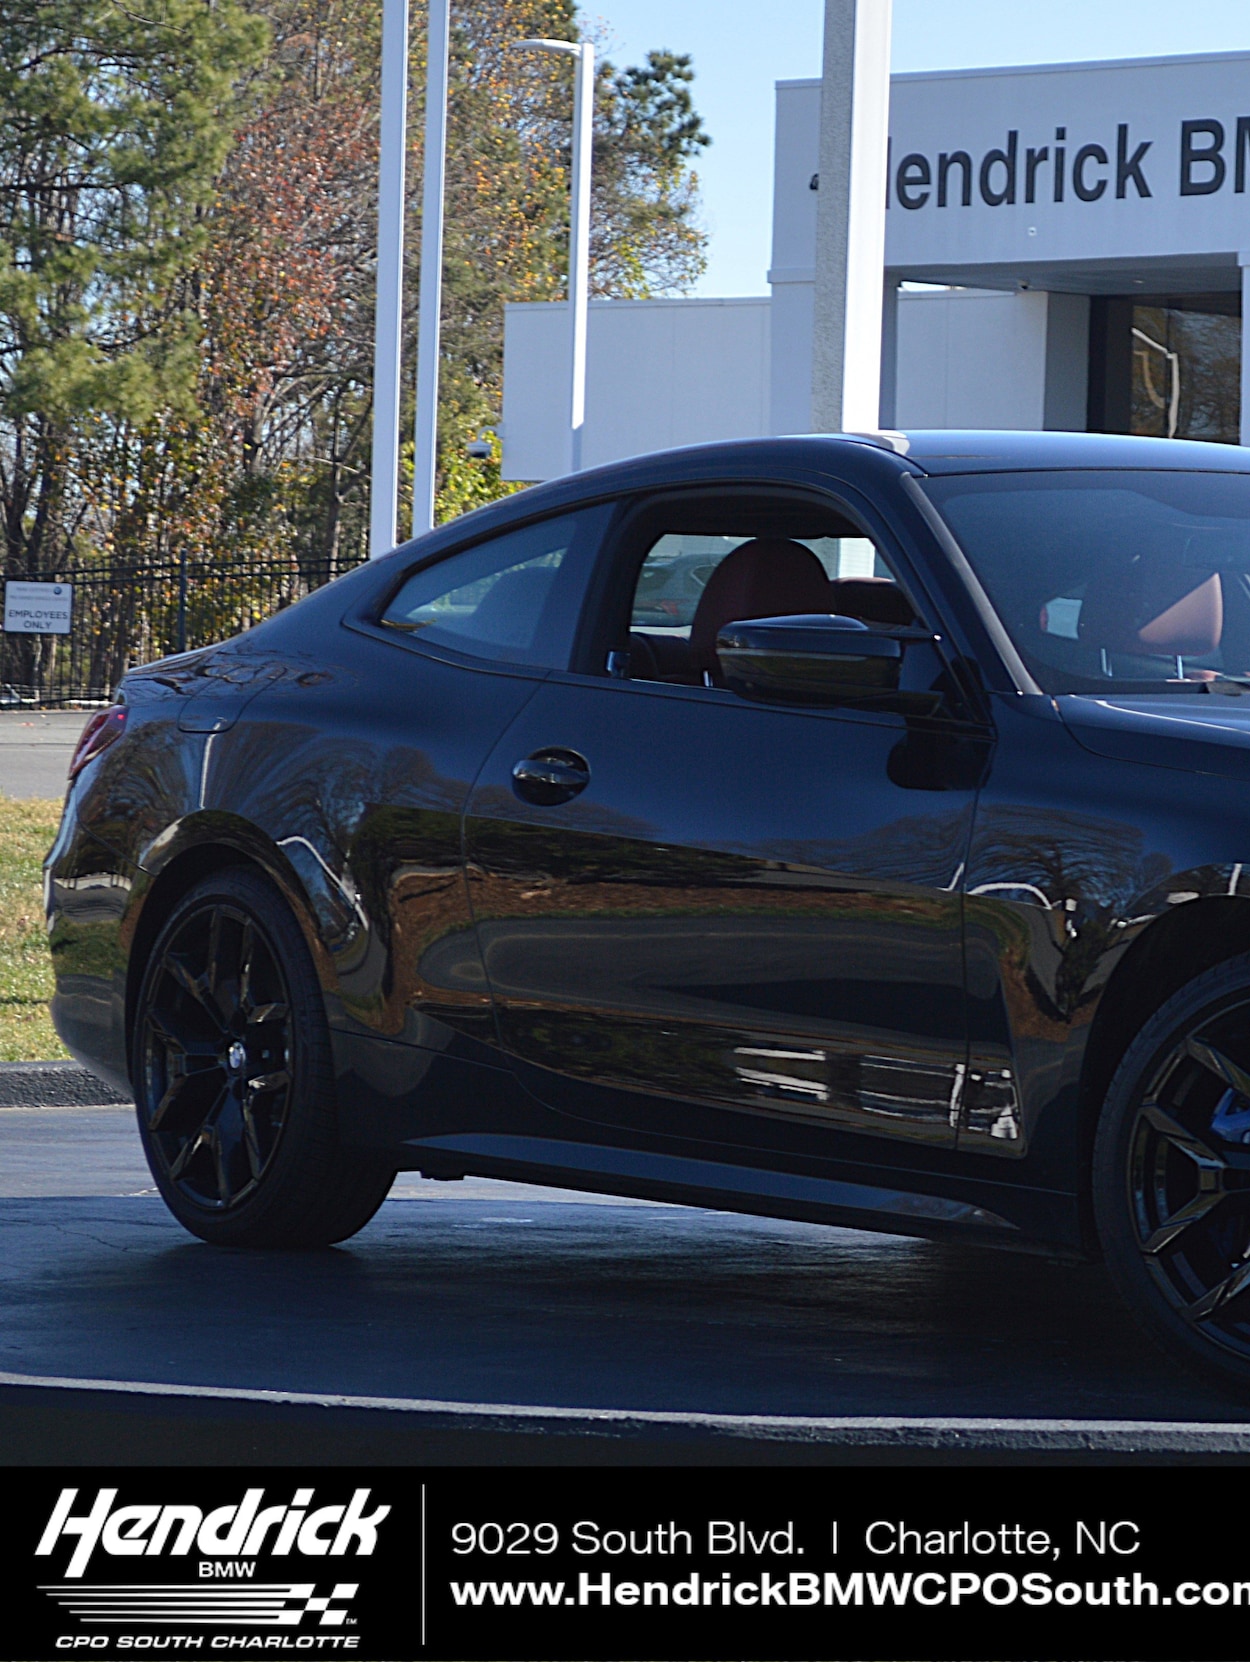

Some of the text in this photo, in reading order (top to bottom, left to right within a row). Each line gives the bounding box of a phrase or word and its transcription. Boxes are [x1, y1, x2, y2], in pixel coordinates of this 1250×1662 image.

[886, 123, 1153, 210] endrick
[8, 609, 68, 620] EMPLOYEES
[23, 620, 52, 630] ONLY
